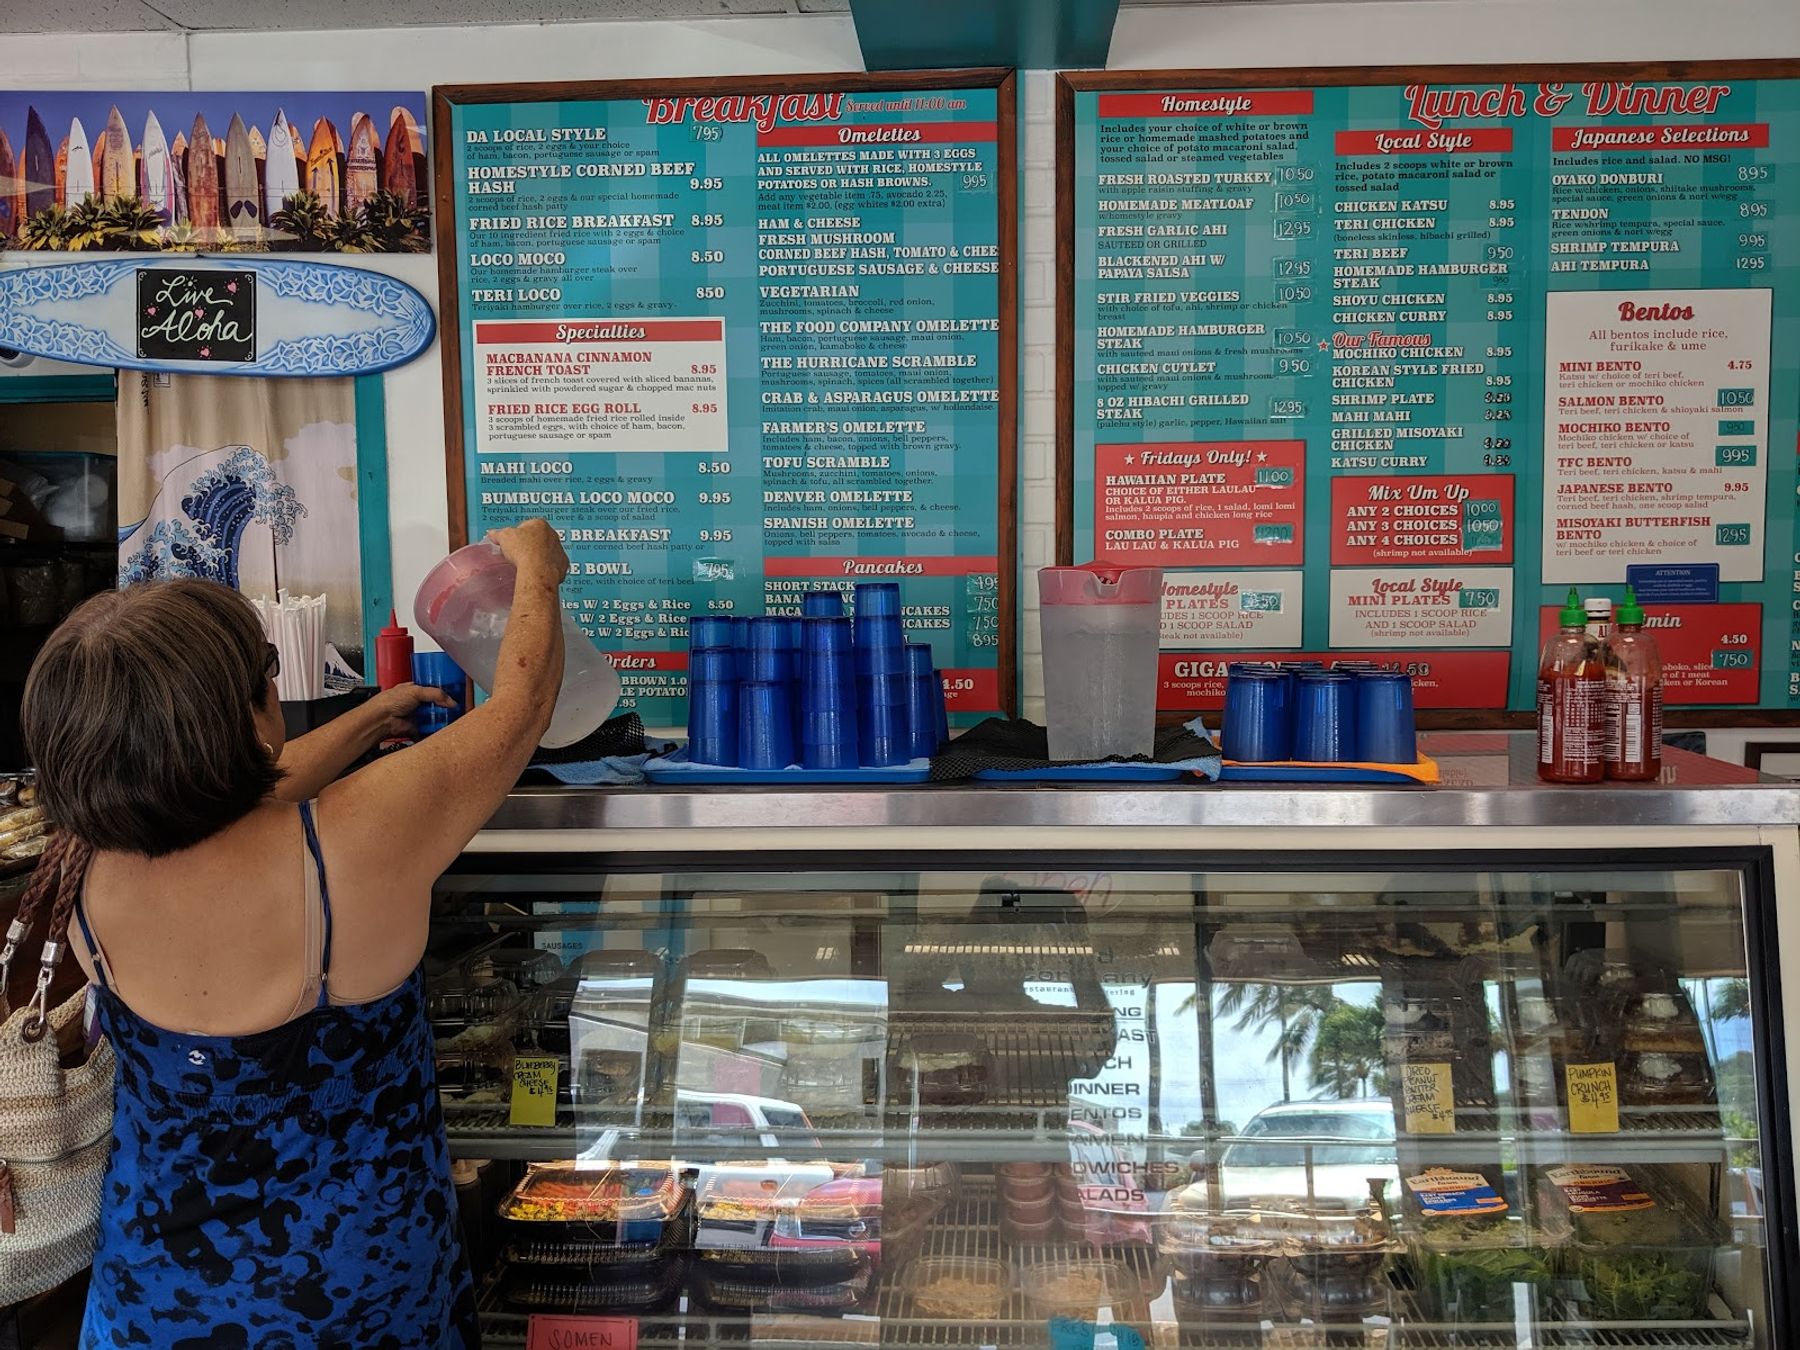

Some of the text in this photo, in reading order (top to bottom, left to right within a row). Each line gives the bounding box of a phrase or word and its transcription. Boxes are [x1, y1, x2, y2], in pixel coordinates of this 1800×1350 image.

[1161, 96, 1251, 115] Homestyle
[1404, 83, 1730, 129] Lunch & Dinner
[1101, 124, 1145, 133] Includes
[1149, 125, 1172, 134] your
[1175, 124, 1205, 132] choice
[1208, 123, 1223, 131] of
[1226, 123, 1255, 131] white
[1273, 122, 1308, 130] brown
[467, 129, 606, 143] DA LOCAL STYLE
[838, 128, 921, 143] Omelettes
[1571, 127, 1748, 149] Japanese Selections
[1375, 133, 1472, 153] Local Style
[468, 163, 695, 179] HOMESTYLE CORNED BEEF
[1098, 172, 1272, 185] FRESH ROASTED TURKEY
[1552, 174, 1663, 185] OYAKO DONBURI
[468, 178, 722, 194] HASH 9.95
[1098, 199, 1253, 211] HOMEMADE MEATLOAF
[1335, 200, 1514, 213] CHICKEN KATSU 8.95
[1552, 209, 1608, 220] TENDON
[470, 214, 723, 230] FRIED RICE BREAKFAST 8.95
[758, 218, 860, 229] HAM & CHEESE
[1334, 218, 1514, 230] TERI CHICKEN 8.95
[1098, 225, 1227, 237] FRESH GARLIC AHI
[1551, 241, 1679, 254] SHRIMP TEMPURA
[471, 252, 724, 266] LOCO MOCO 8.50
[1551, 260, 1649, 272] AHI TEMPURA
[155, 276, 233, 307] Live
[760, 286, 859, 298] VEGETARIAN
[1618, 302, 1695, 321] Bentos
[141, 310, 253, 343] Aloha
[556, 325, 646, 343] Specialties
[1332, 331, 1431, 348] Our Famous
[1589, 329, 1728, 340] All bentos include rice,
[487, 352, 652, 364] MACBANANA CINNAMON
[1333, 347, 1511, 359] MOCHIKO CHICKEN 8.95
[761, 356, 976, 368] THE HURRICANE SCRAMBLE
[1097, 362, 1216, 374] CHICKEN CUTLET
[1560, 361, 1752, 372] MINI BENTO 4.75
[487, 365, 717, 375] FRENCH TOAST 8.95
[1559, 396, 1664, 407] SALMON BENTO
[489, 404, 717, 415] FRIED RICE EGG ROLL 8.95
[762, 422, 925, 433] FARMER'S OMELETTE
[1140, 450, 1252, 467] Fridays Only!
[1722, 449, 1749, 462] 995
[763, 457, 889, 468] TOFU SCRAMBLE
[1106, 474, 1225, 485] HAWAIIAN PLATE
[482, 492, 731, 504] BUMBUCHA LOCO MOCO 9.95
[1368, 485, 1469, 502] Mix Um Up
[1347, 505, 1458, 517] ANY 2 CHOICES
[764, 518, 915, 529] SPANISH OMELETTE
[842, 560, 923, 575] Pancakes
[765, 581, 856, 591] SHORT STACK
[1372, 578, 1463, 596] Local Style
[1348, 595, 1450, 606] MINI PLATES
[1721, 634, 1748, 644] 4.50
[1071, 1108, 1142, 1119] ENTOS
[1073, 1161, 1178, 1174] DWICHES
[1077, 1189, 1144, 1201] ALADS
[549, 1332, 612, 1350] SOMEN
